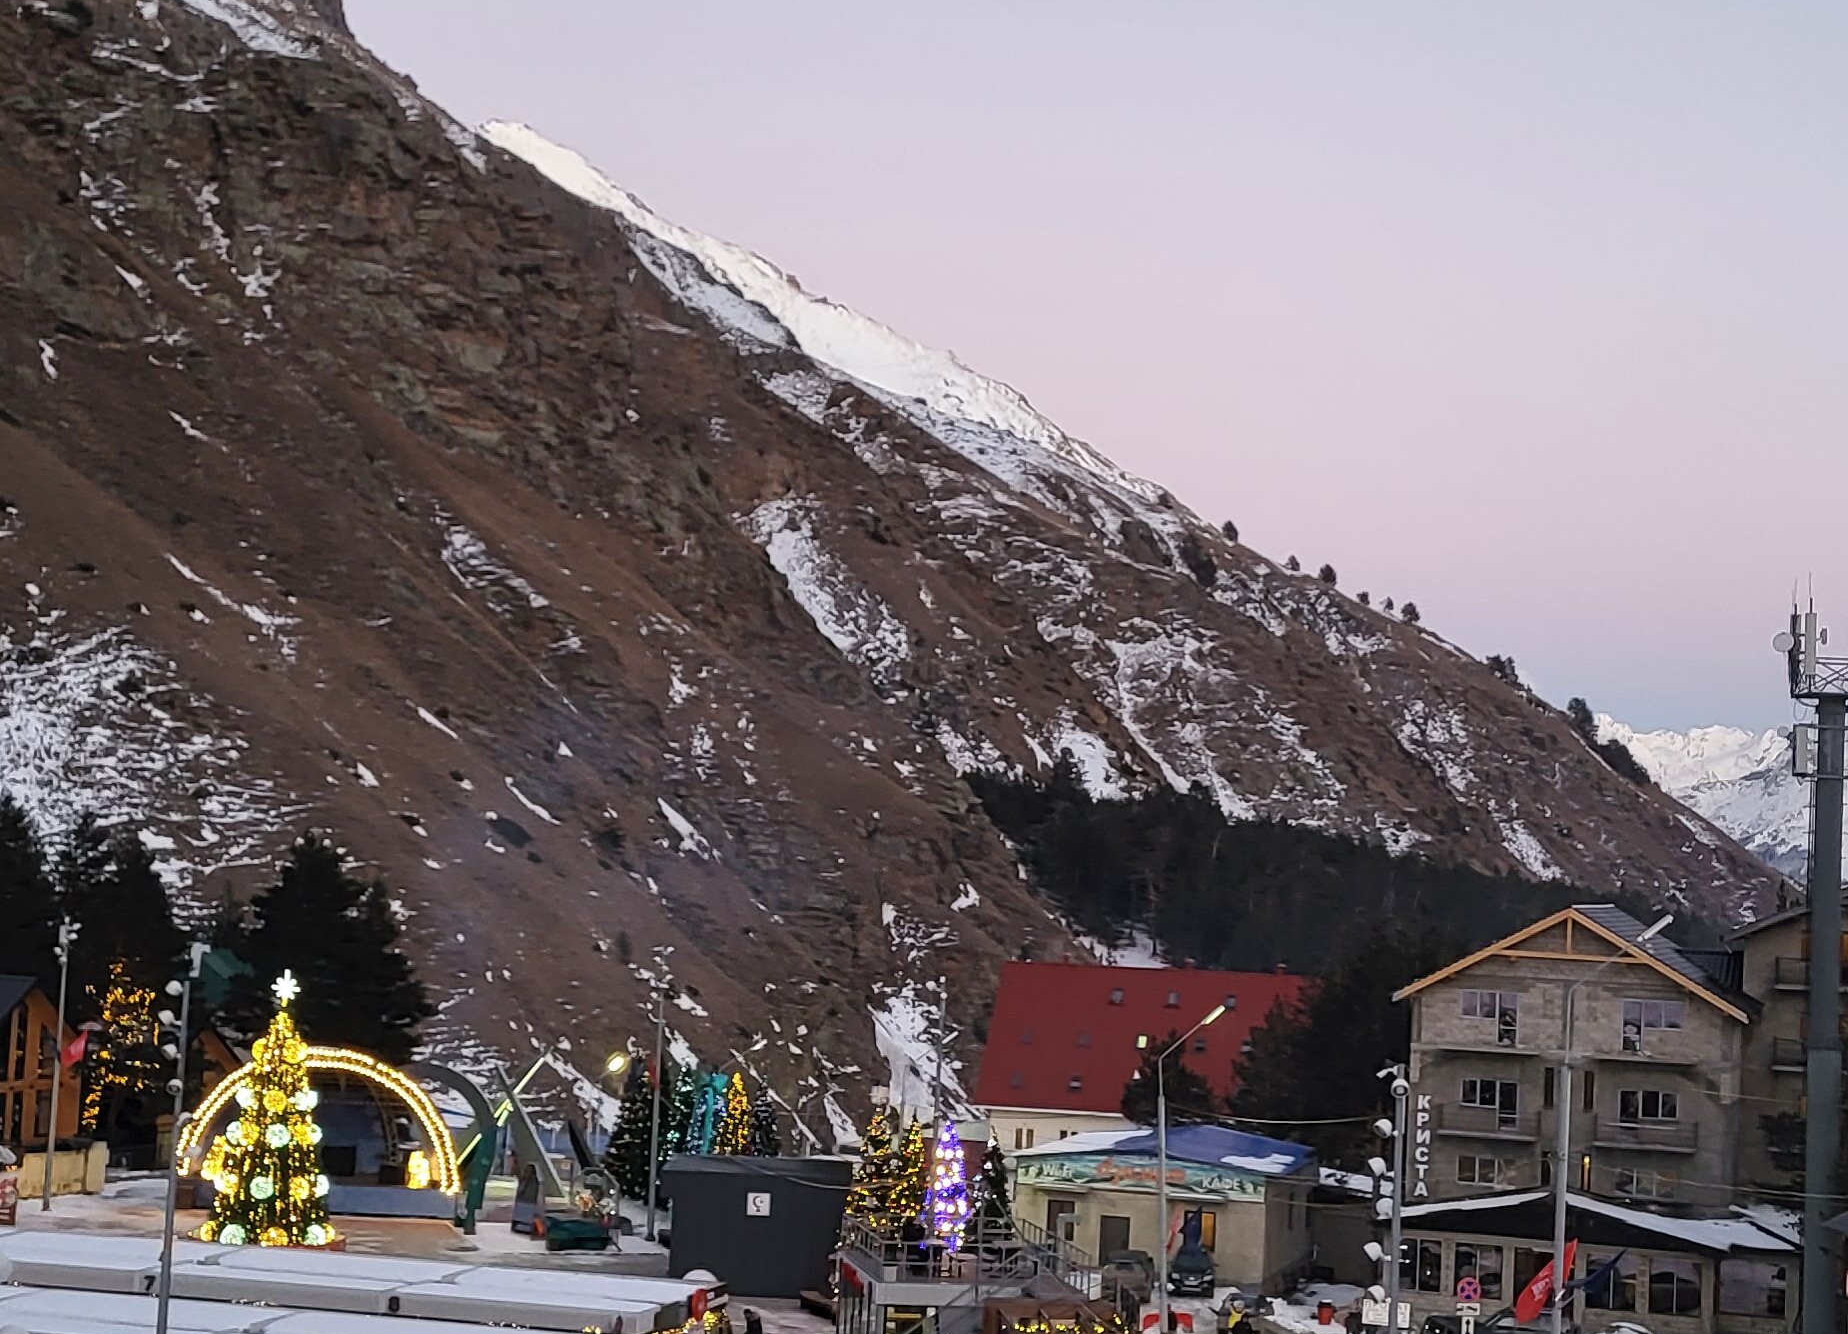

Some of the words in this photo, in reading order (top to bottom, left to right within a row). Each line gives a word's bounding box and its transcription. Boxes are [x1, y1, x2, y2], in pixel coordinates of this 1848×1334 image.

[1413, 1094, 1432, 1197] КРИСТА
[1202, 1176, 1240, 1190] КАФЕ
[144, 1274, 156, 1292] 7
